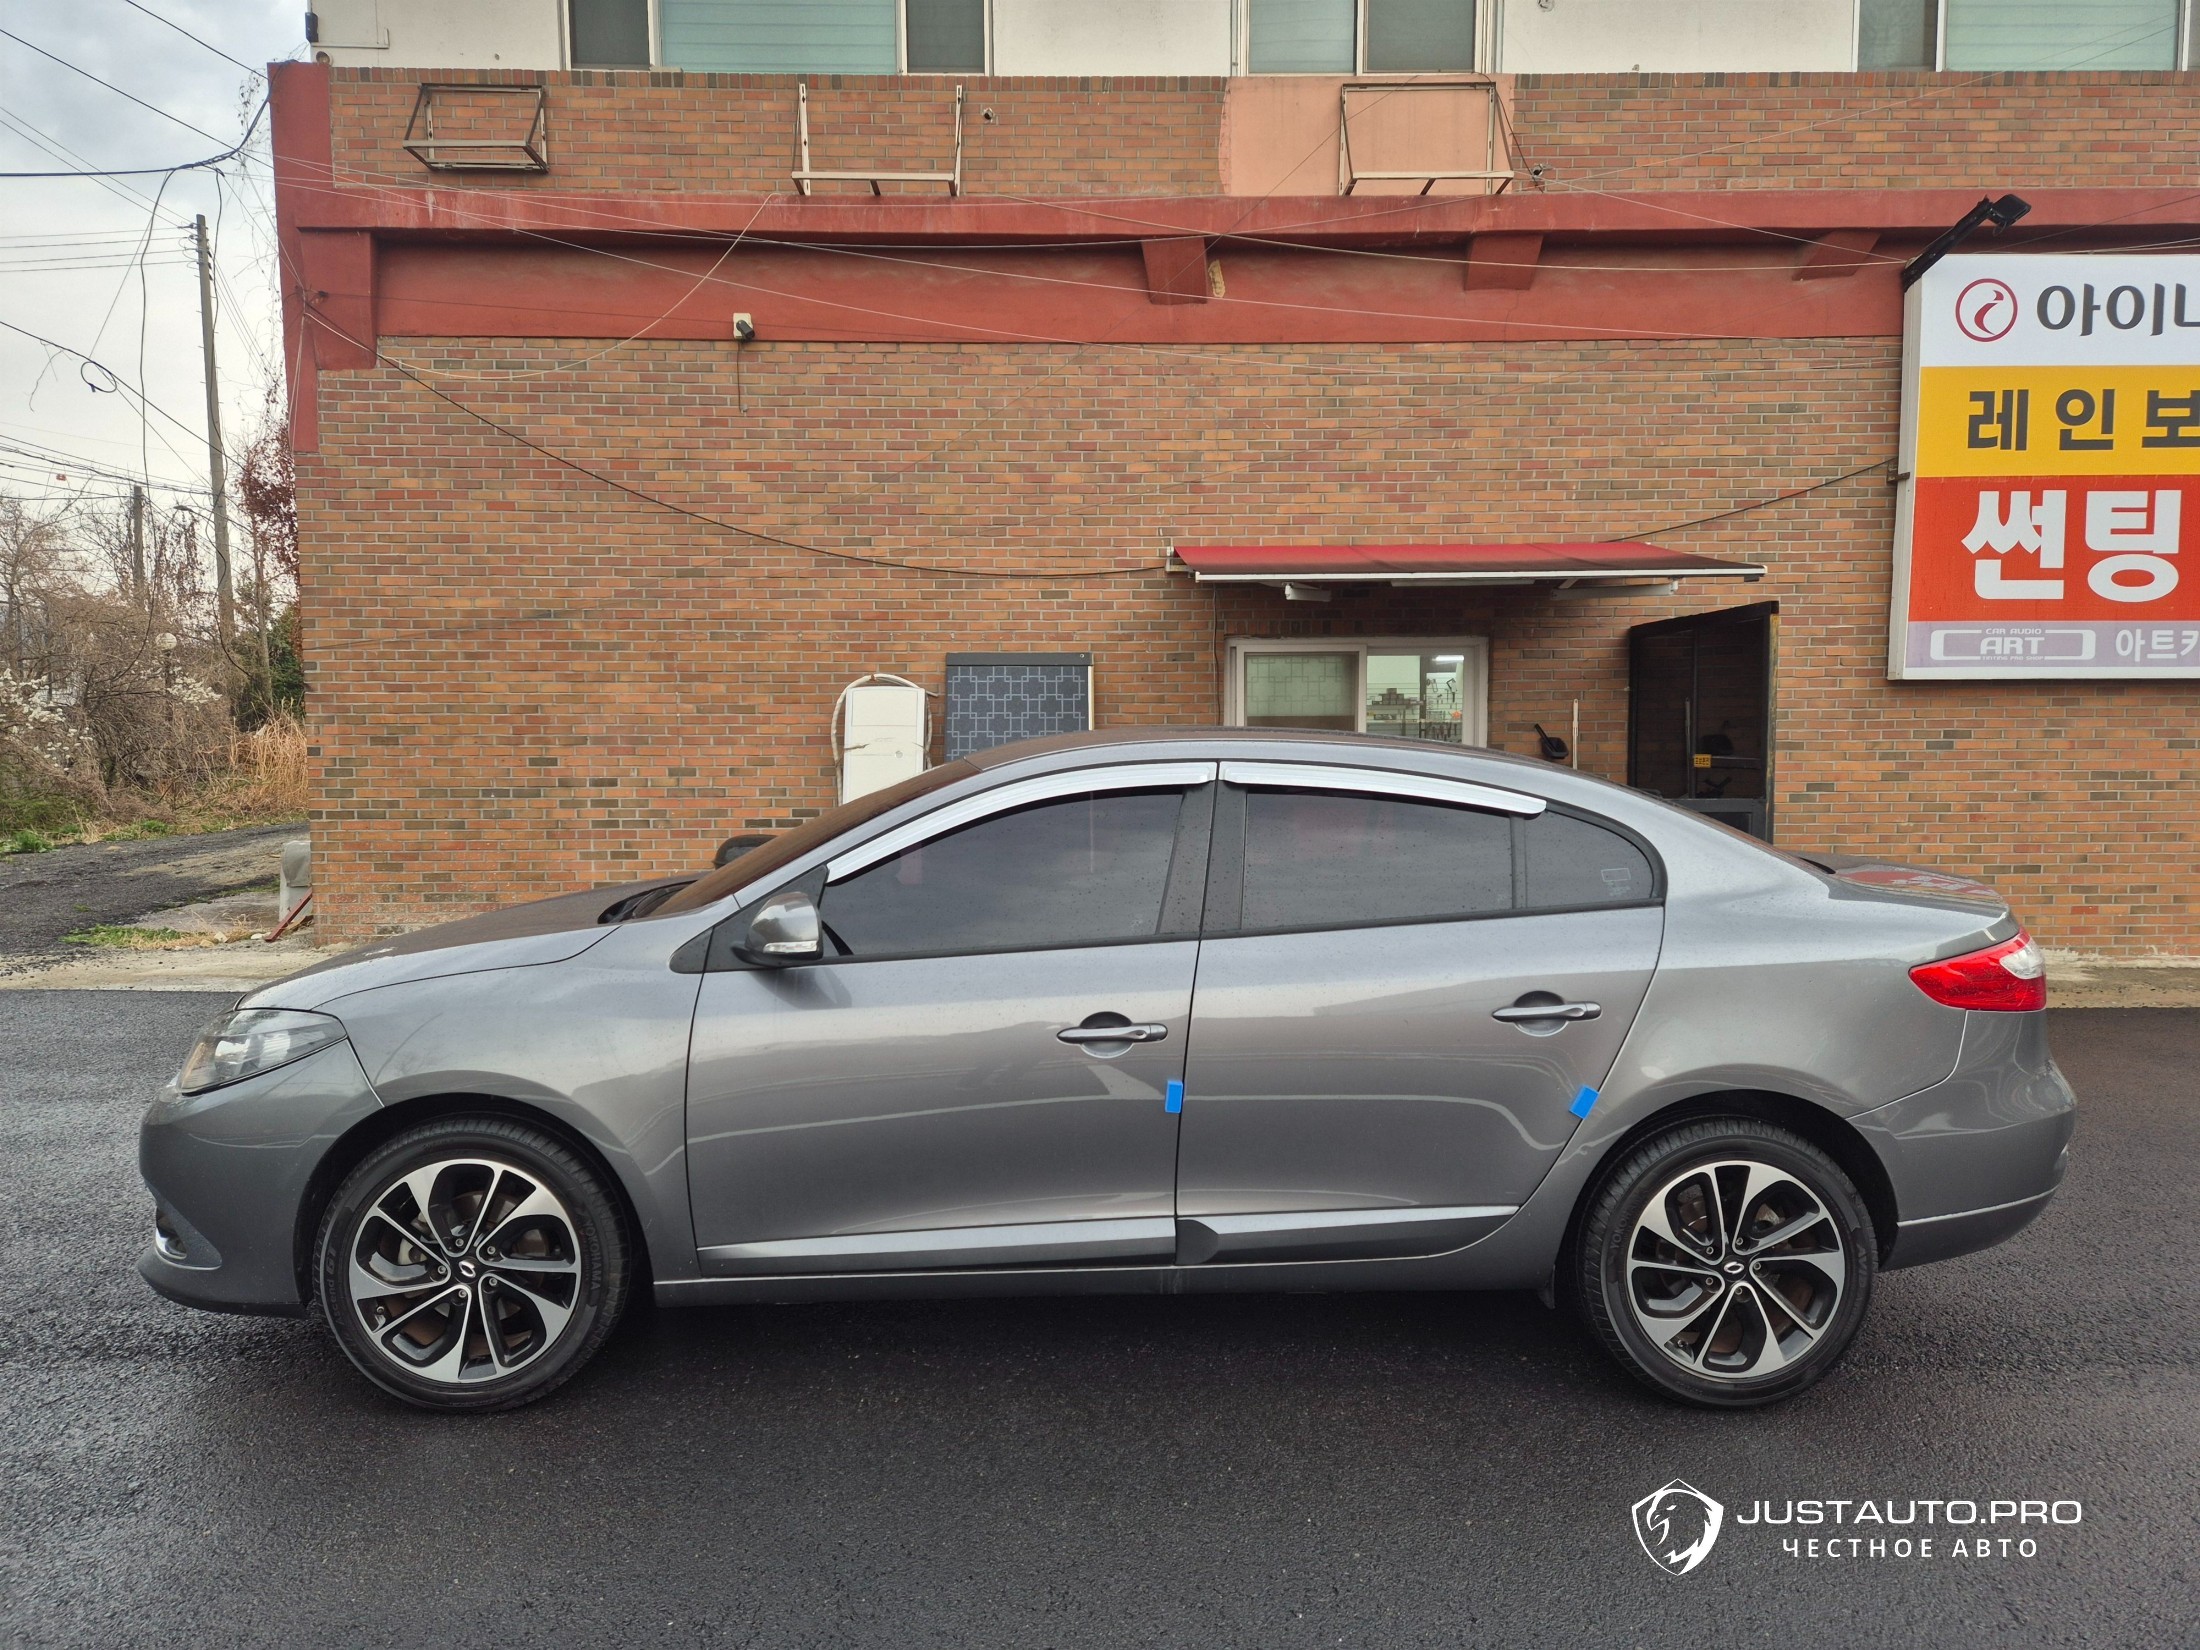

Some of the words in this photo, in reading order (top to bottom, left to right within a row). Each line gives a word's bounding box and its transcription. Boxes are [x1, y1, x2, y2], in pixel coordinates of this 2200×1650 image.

[1961, 490, 2182, 602] 썬팅
[1980, 636, 2045, 655] ART
[325, 1247, 337, 1276] GT
[583, 1219, 602, 1290] YOKOHAMA
[326, 1279, 345, 1326] Ascend
